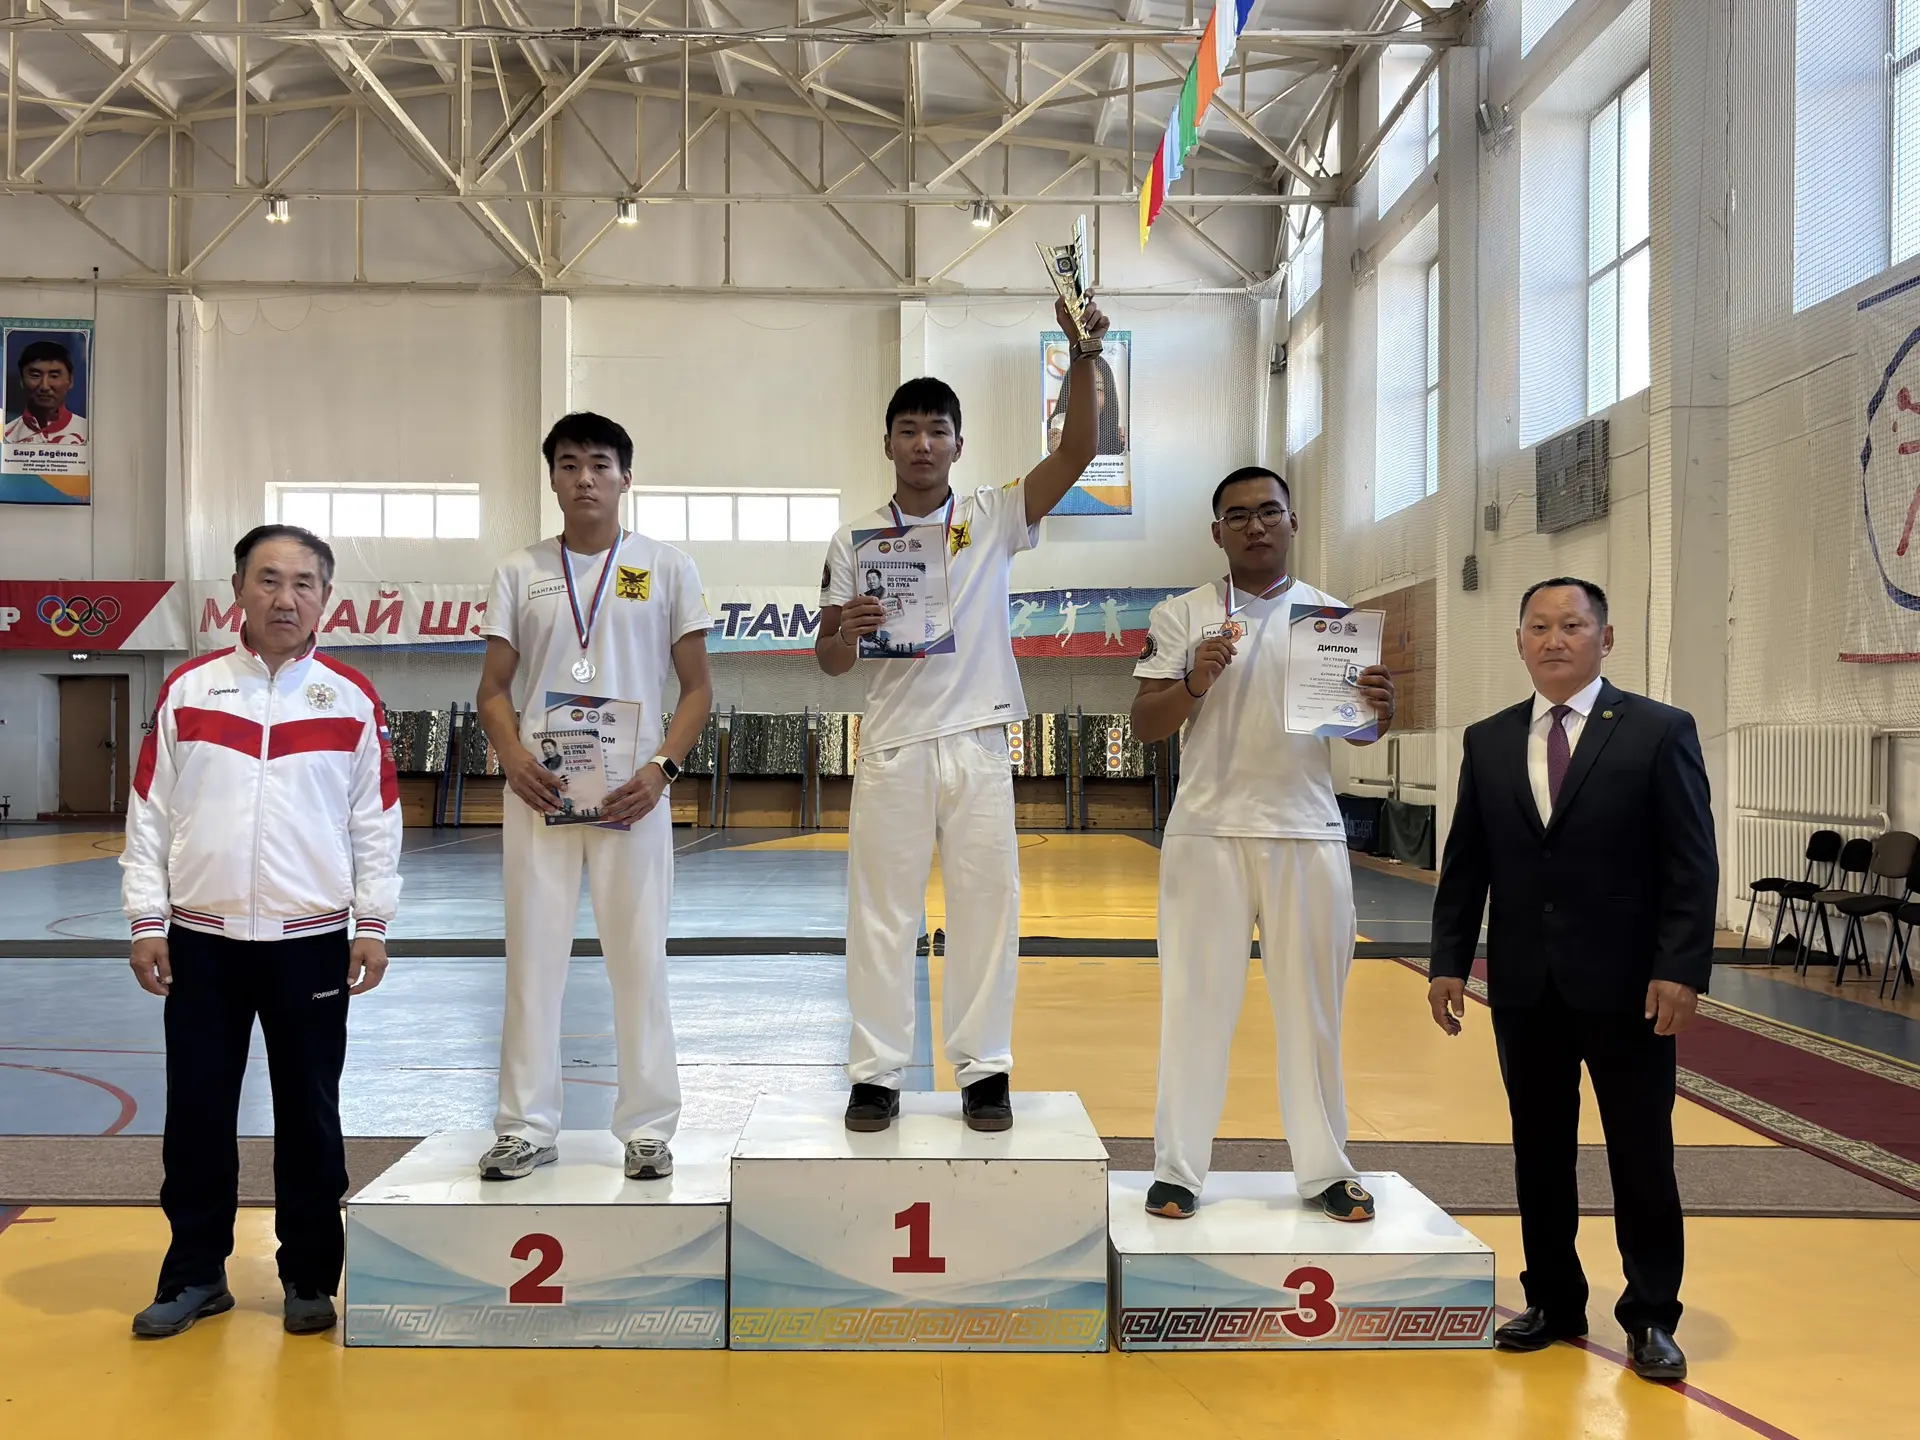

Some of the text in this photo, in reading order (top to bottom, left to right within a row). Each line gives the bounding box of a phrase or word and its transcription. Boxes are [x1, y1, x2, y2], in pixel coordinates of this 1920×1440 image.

[13, 449, 36, 458] Баир
[200, 590, 404, 635] МАЙ
[1317, 644, 1358, 654] ДИПЛОМ
[892, 1202, 945, 1273] 1
[509, 1233, 563, 1303] 2
[1280, 1266, 1337, 1338] 3
